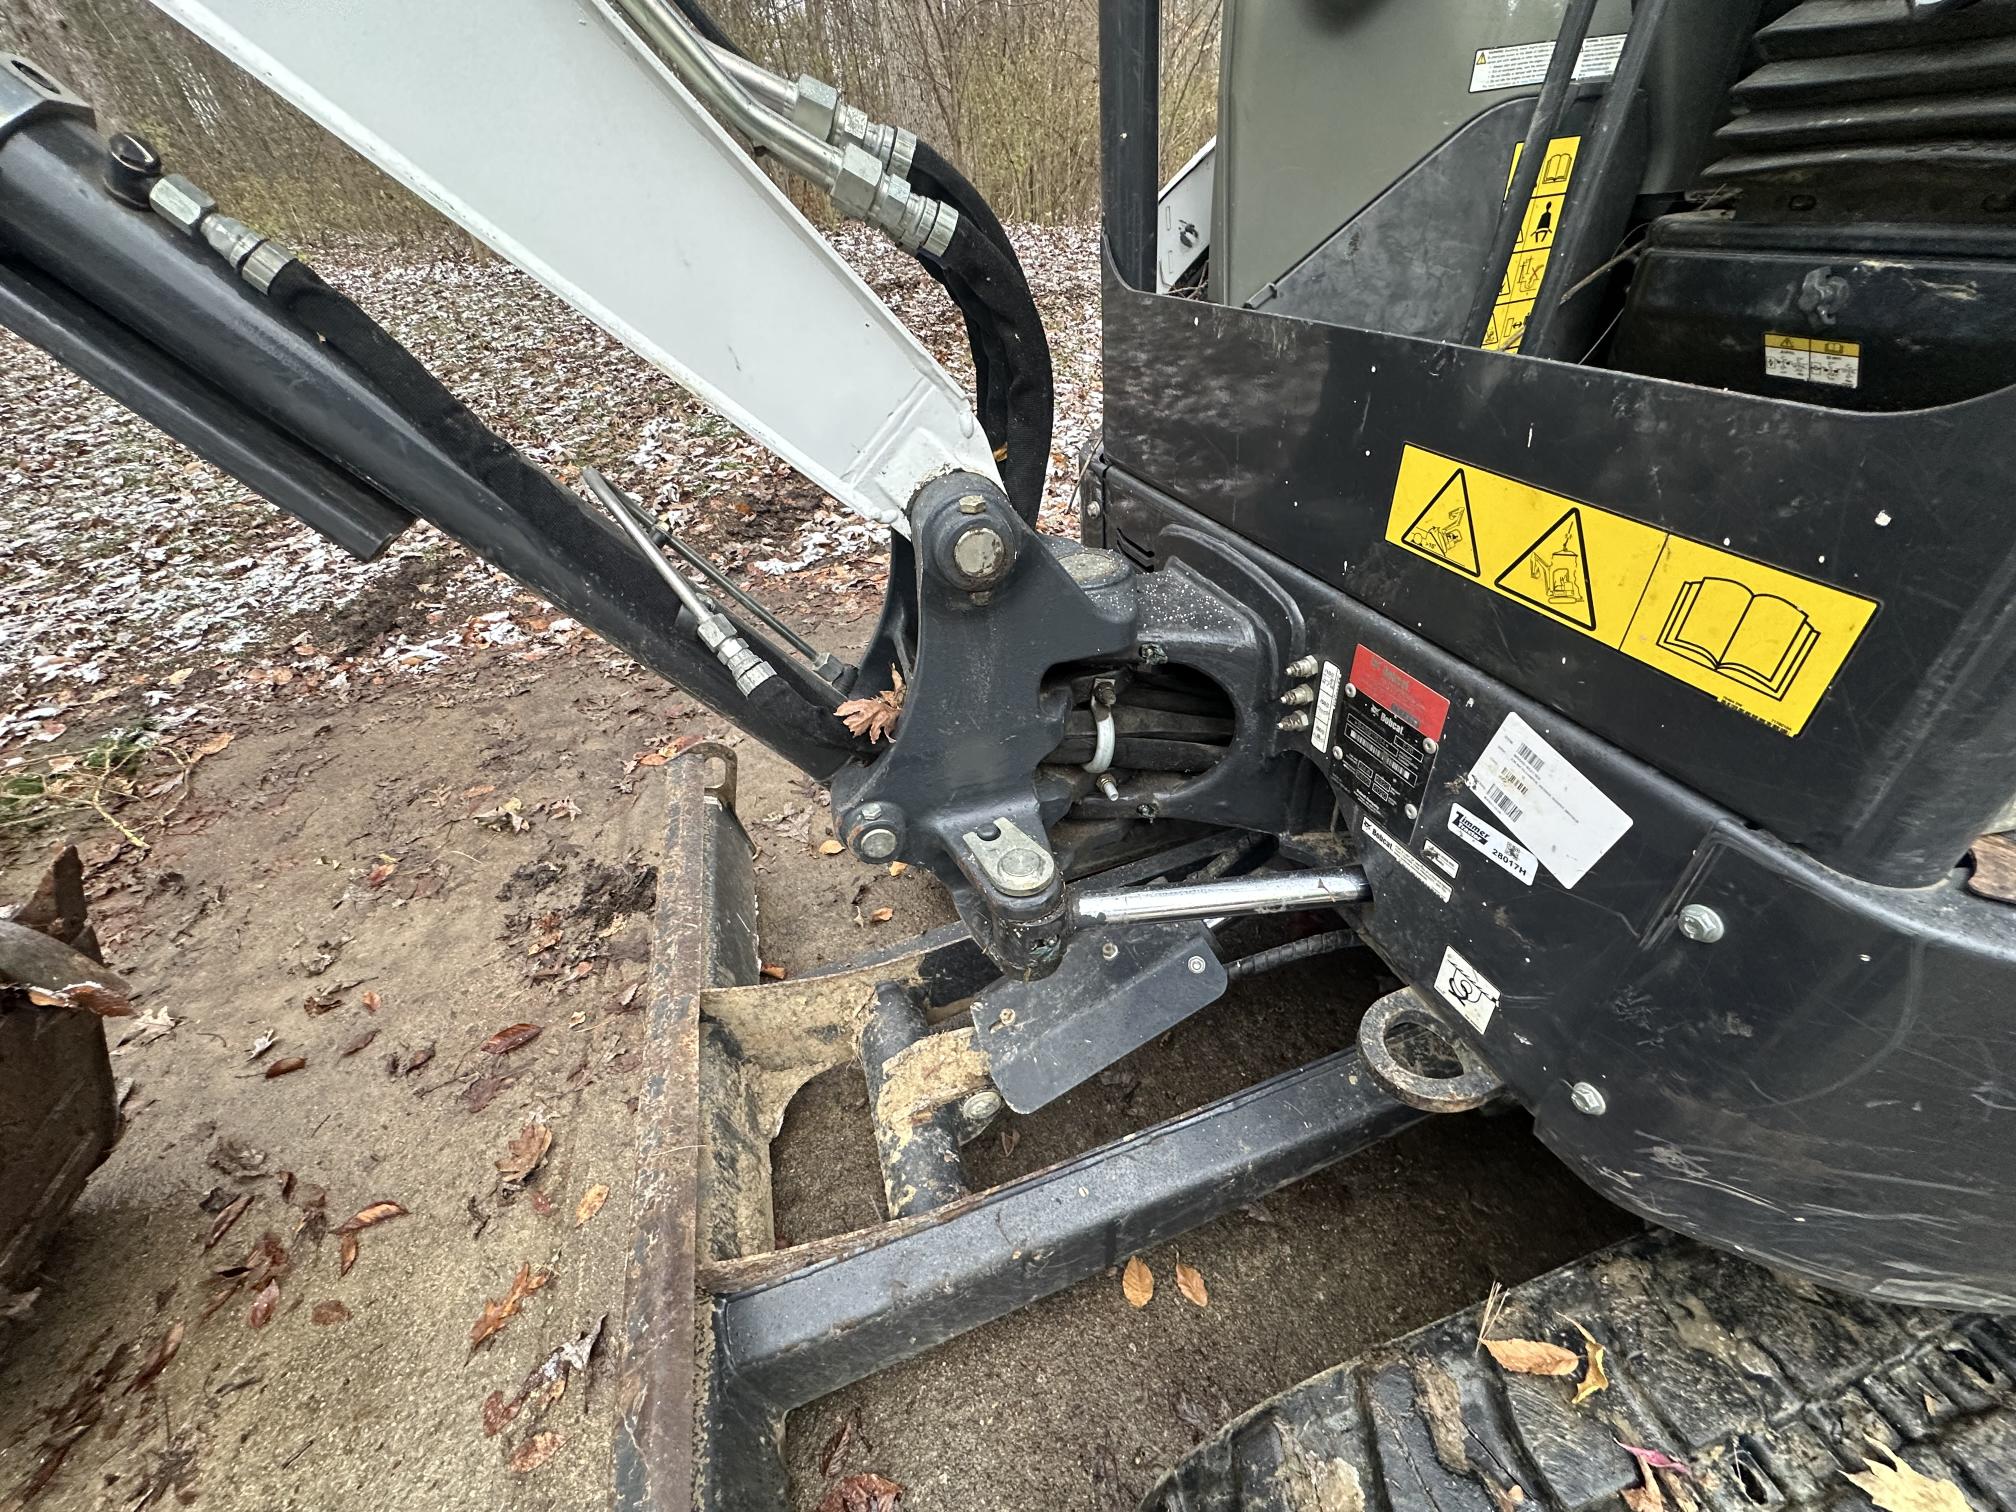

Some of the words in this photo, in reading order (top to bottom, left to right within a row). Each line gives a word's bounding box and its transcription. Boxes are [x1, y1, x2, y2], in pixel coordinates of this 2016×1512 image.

[1380, 712, 1404, 735] Bobcat
[1452, 811, 1490, 839] Zimmer
[1371, 828, 1394, 851] Bobcat
[1491, 847, 1527, 876] 28017H
